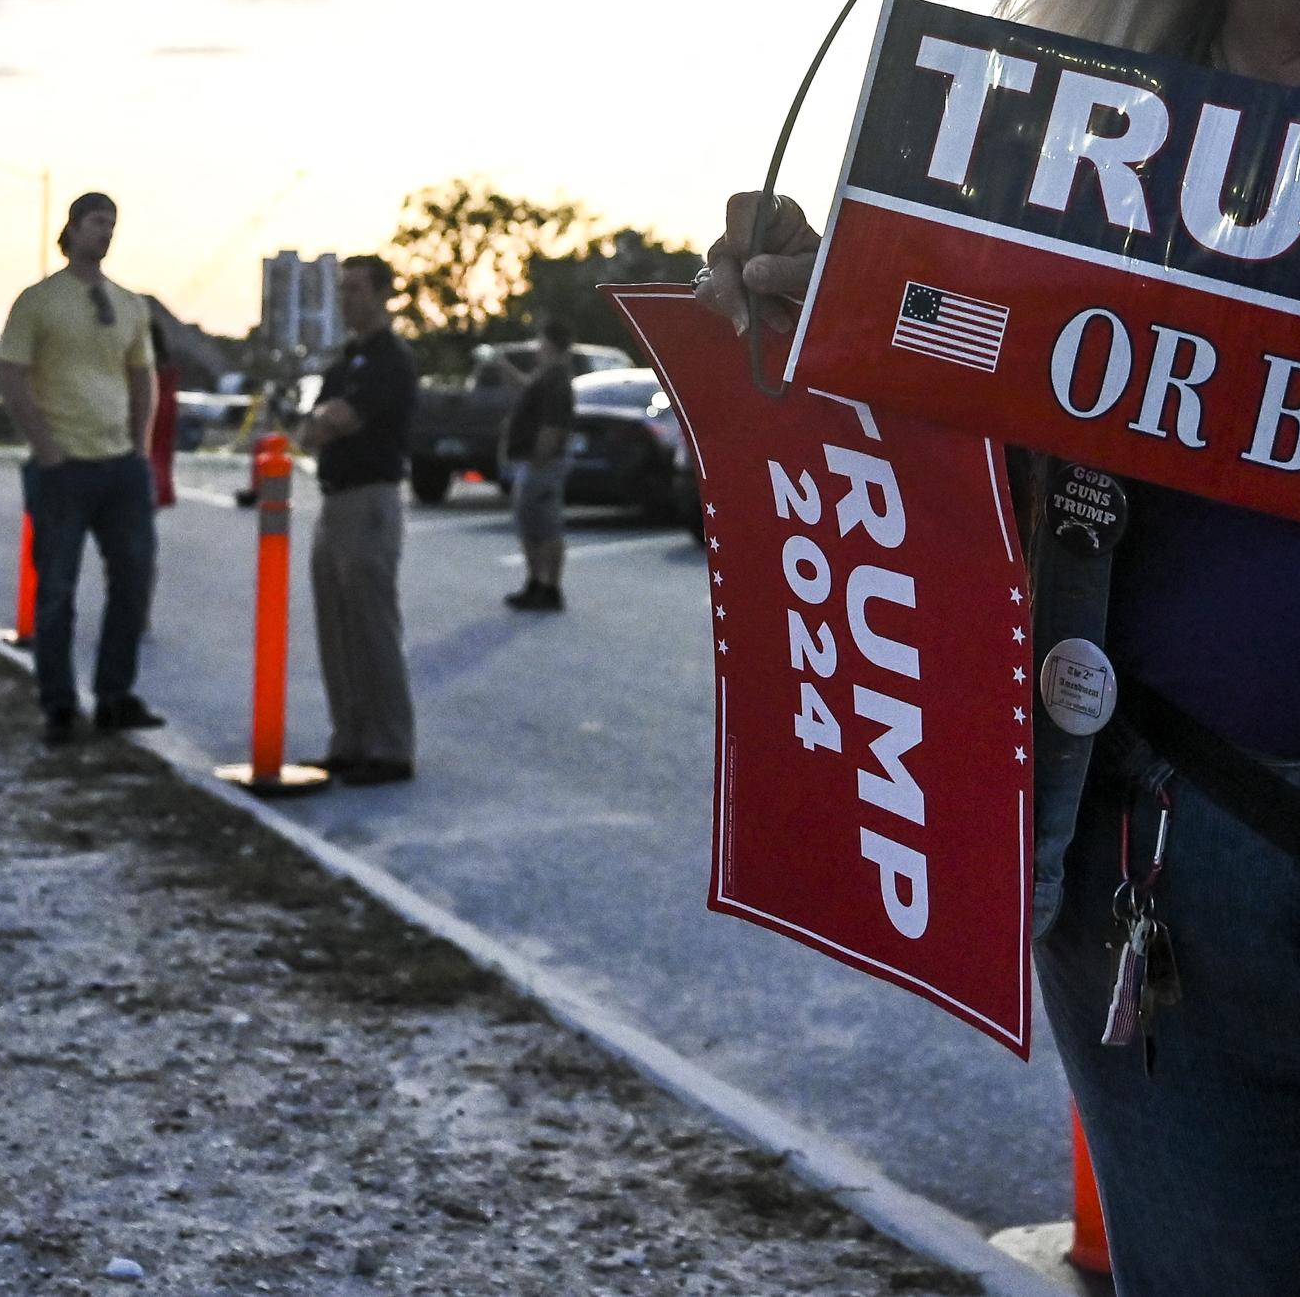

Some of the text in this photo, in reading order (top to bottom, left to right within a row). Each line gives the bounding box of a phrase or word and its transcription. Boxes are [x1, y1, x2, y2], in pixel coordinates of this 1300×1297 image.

[1050, 308, 1220, 449] OR
[1073, 466, 1112, 489] GOD
[1053, 494, 1117, 525] TRUMP
[1066, 481, 1112, 507] GUNS
[767, 459, 843, 754] 2024
